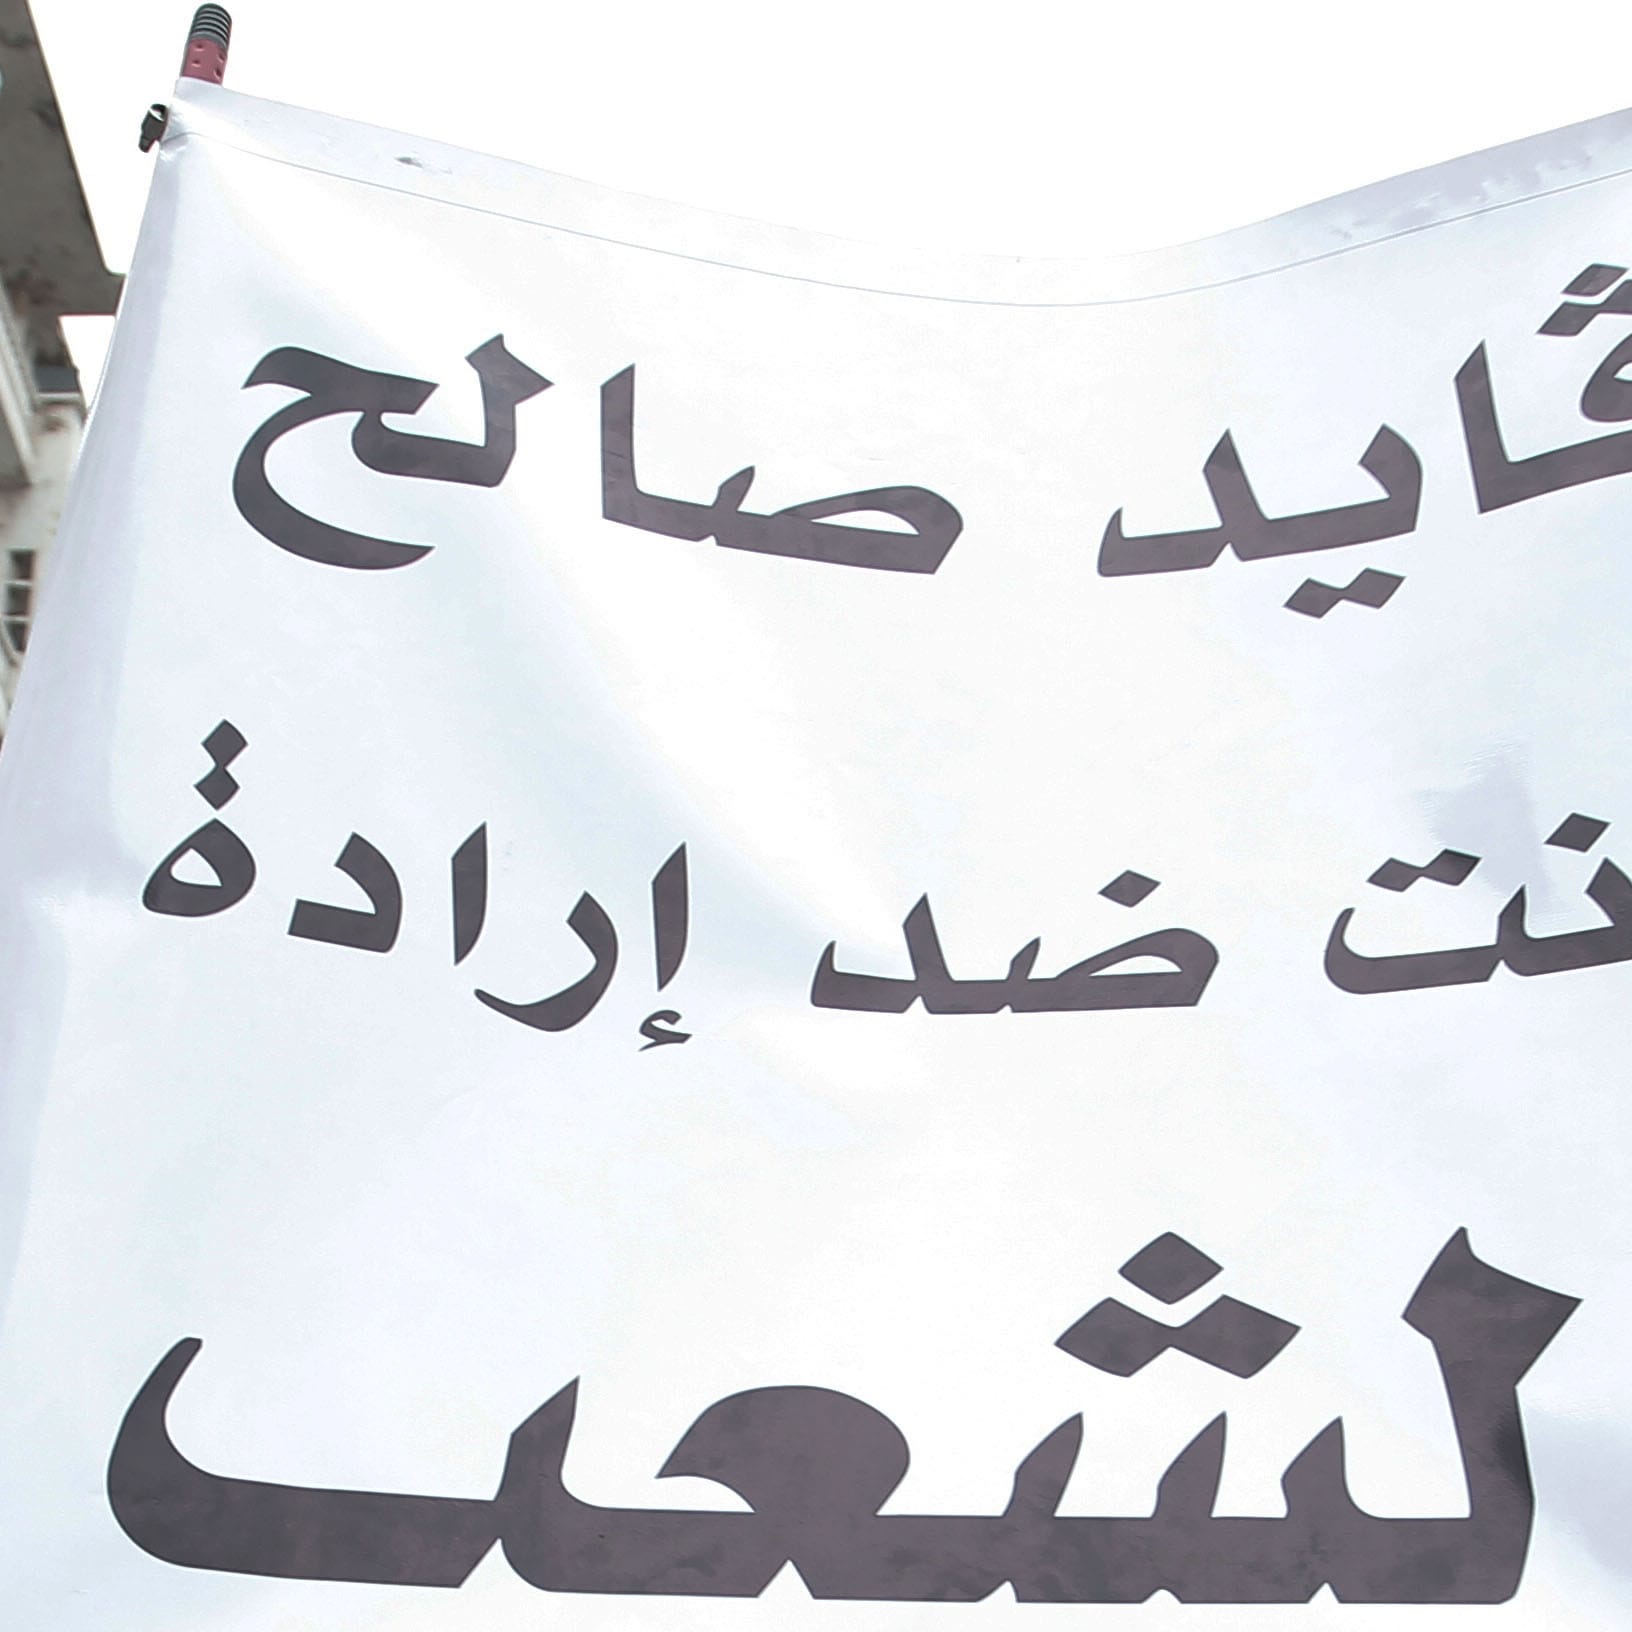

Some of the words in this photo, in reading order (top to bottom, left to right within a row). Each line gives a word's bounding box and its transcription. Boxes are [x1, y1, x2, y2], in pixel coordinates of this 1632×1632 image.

[233, 334, 963, 574] صالح
[143, 720, 688, 1050] إرادة
[811, 871, 1218, 1014] ضد
